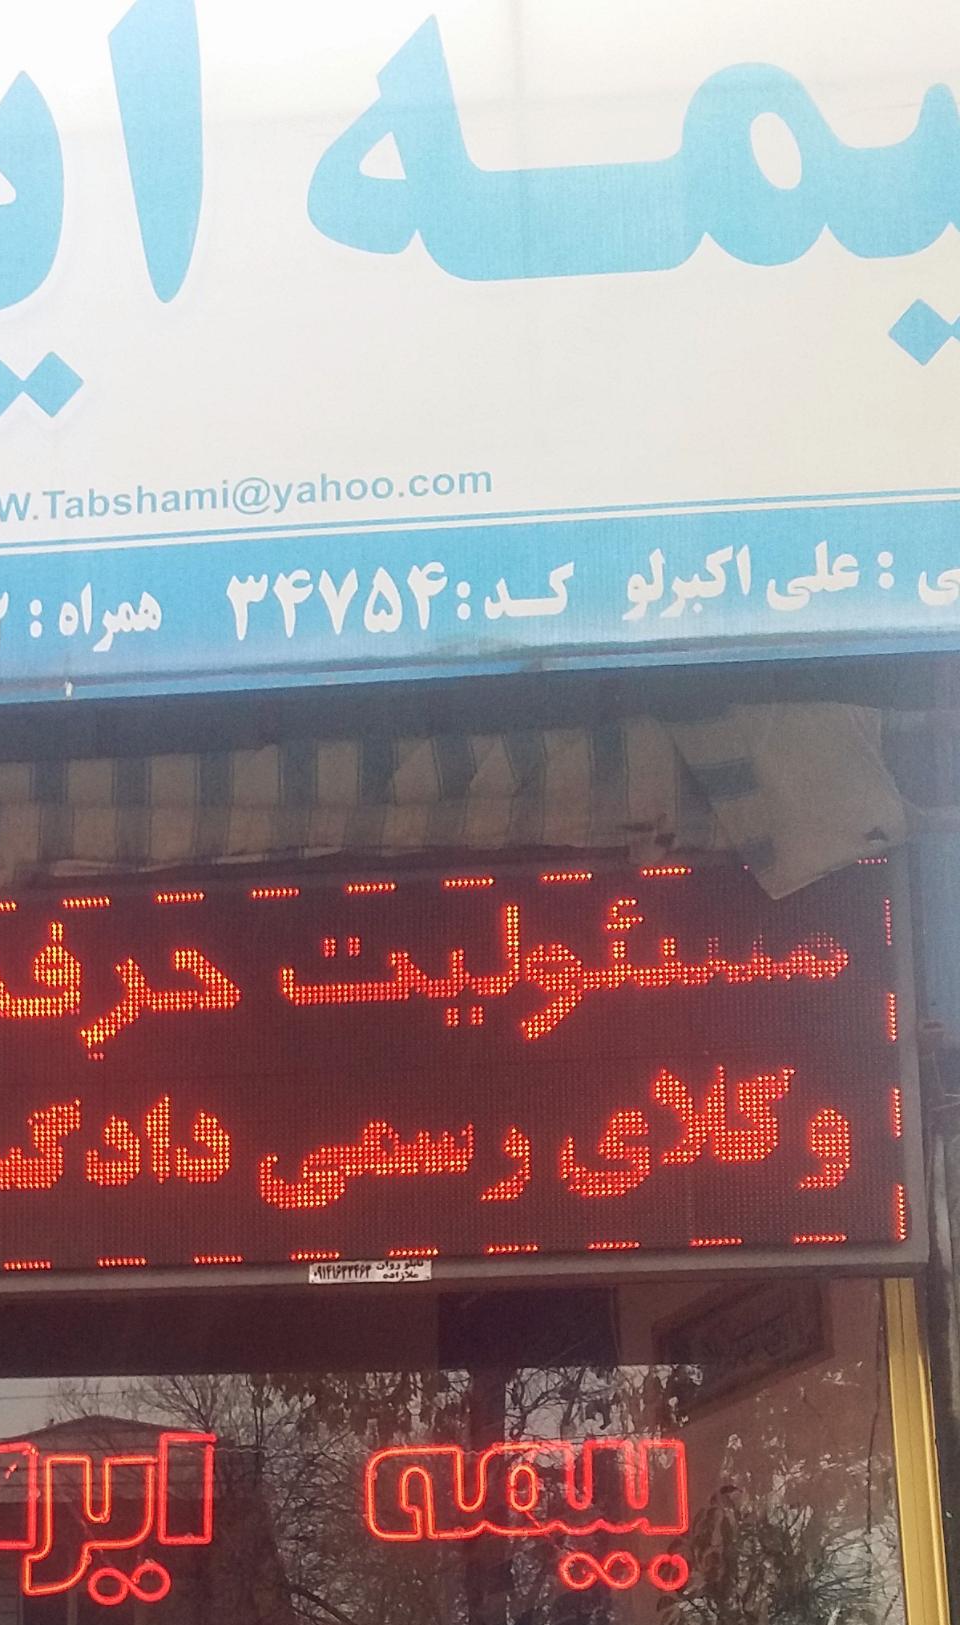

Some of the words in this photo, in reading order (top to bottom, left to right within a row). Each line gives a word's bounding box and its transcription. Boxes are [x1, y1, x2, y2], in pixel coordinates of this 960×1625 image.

[306, 14, 960, 366] یمه
[226, 561, 448, 641] ۳۴۷۵۴
[622, 544, 752, 621] اکبرلو
[766, 541, 860, 611] علی
[279, 899, 850, 1042] مسئولیت
[259, 1119, 533, 1211] رسمی
[558, 1065, 852, 1198] وکلای
[364, 1438, 690, 1592] بیمه
